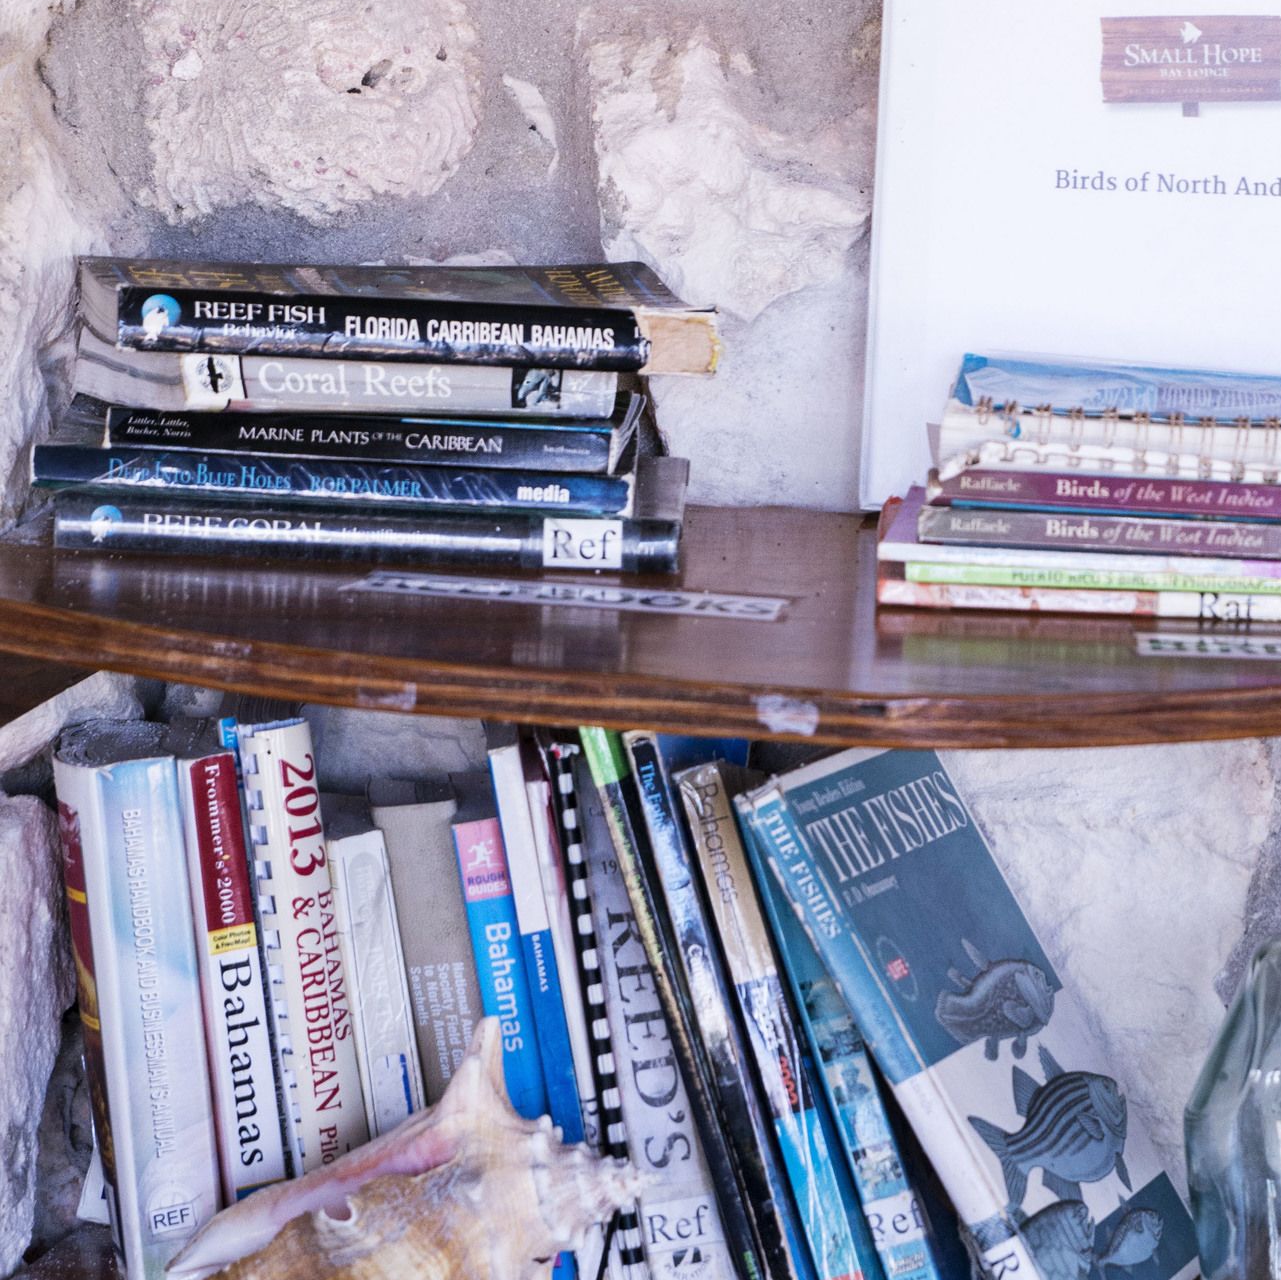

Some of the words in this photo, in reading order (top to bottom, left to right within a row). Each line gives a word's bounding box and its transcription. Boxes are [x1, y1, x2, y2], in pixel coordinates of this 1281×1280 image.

[1124, 44, 1198, 66] SMALL
[1204, 44, 1262, 65] HOPE
[1160, 68, 1184, 78] BAY
[1188, 68, 1229, 77] LODGE
[1054, 169, 1118, 192] Birds
[1125, 170, 1150, 193] of
[1157, 174, 1226, 196] North
[194, 301, 262, 320] REEF
[268, 304, 325, 324] FISH
[223, 323, 297, 339] Behavior
[345, 316, 420, 341] FLORIDA
[427, 319, 524, 346] CARRIBEAN
[531, 324, 614, 349] BAHAMAS
[259, 362, 347, 396] Coral
[364, 366, 451, 398] Reefs
[239, 426, 304, 442] MARINE
[311, 429, 370, 445] PLANTS
[372, 432, 383, 440] OF
[386, 432, 401, 441] THE
[406, 434, 502, 453] CARIBBEAN
[197, 464, 235, 486] BLUE
[241, 466, 291, 489] HOLES
[310, 476, 346, 492] ROB
[350, 477, 422, 498] PALMER
[517, 484, 570, 503] media
[960, 476, 1022, 492] Raffaele
[1056, 479, 1110, 498] Birds
[1114, 483, 1134, 503] of
[1137, 483, 1164, 502] the
[1170, 485, 1212, 504] West
[1217, 488, 1274, 508] Indies
[553, 529, 616, 560] Ref
[950, 517, 1010, 533] Raffaele
[1046, 520, 1099, 538] Birds
[1103, 524, 1122, 543] of
[1126, 524, 1154, 542] the
[1159, 527, 1200, 543] West
[1206, 528, 1263, 548] Indies
[204, 763, 231, 870] Frommer's
[280, 754, 326, 876] 2013
[806, 806, 885, 882] THE
[862, 771, 968, 859] FISHES
[701, 782, 738, 904] Bahamas
[467, 872, 504, 886] ROUGH
[468, 882, 507, 896] GUIDES
[766, 810, 799, 860] THE
[790, 860, 842, 940] FISHES
[217, 877, 236, 924] 2000
[292, 897, 315, 920] &
[318, 890, 351, 1040] BAHAMAS
[532, 934, 548, 992] BAHAMAS
[484, 922, 523, 1052] Bahamas
[297, 928, 342, 1112] CARIBBEAN
[607, 908, 690, 1169] REED'S
[220, 954, 264, 1166] Bahamas
[153, 1208, 190, 1229] REF
[646, 1205, 708, 1243] Ref
[866, 1198, 924, 1242] Ref
